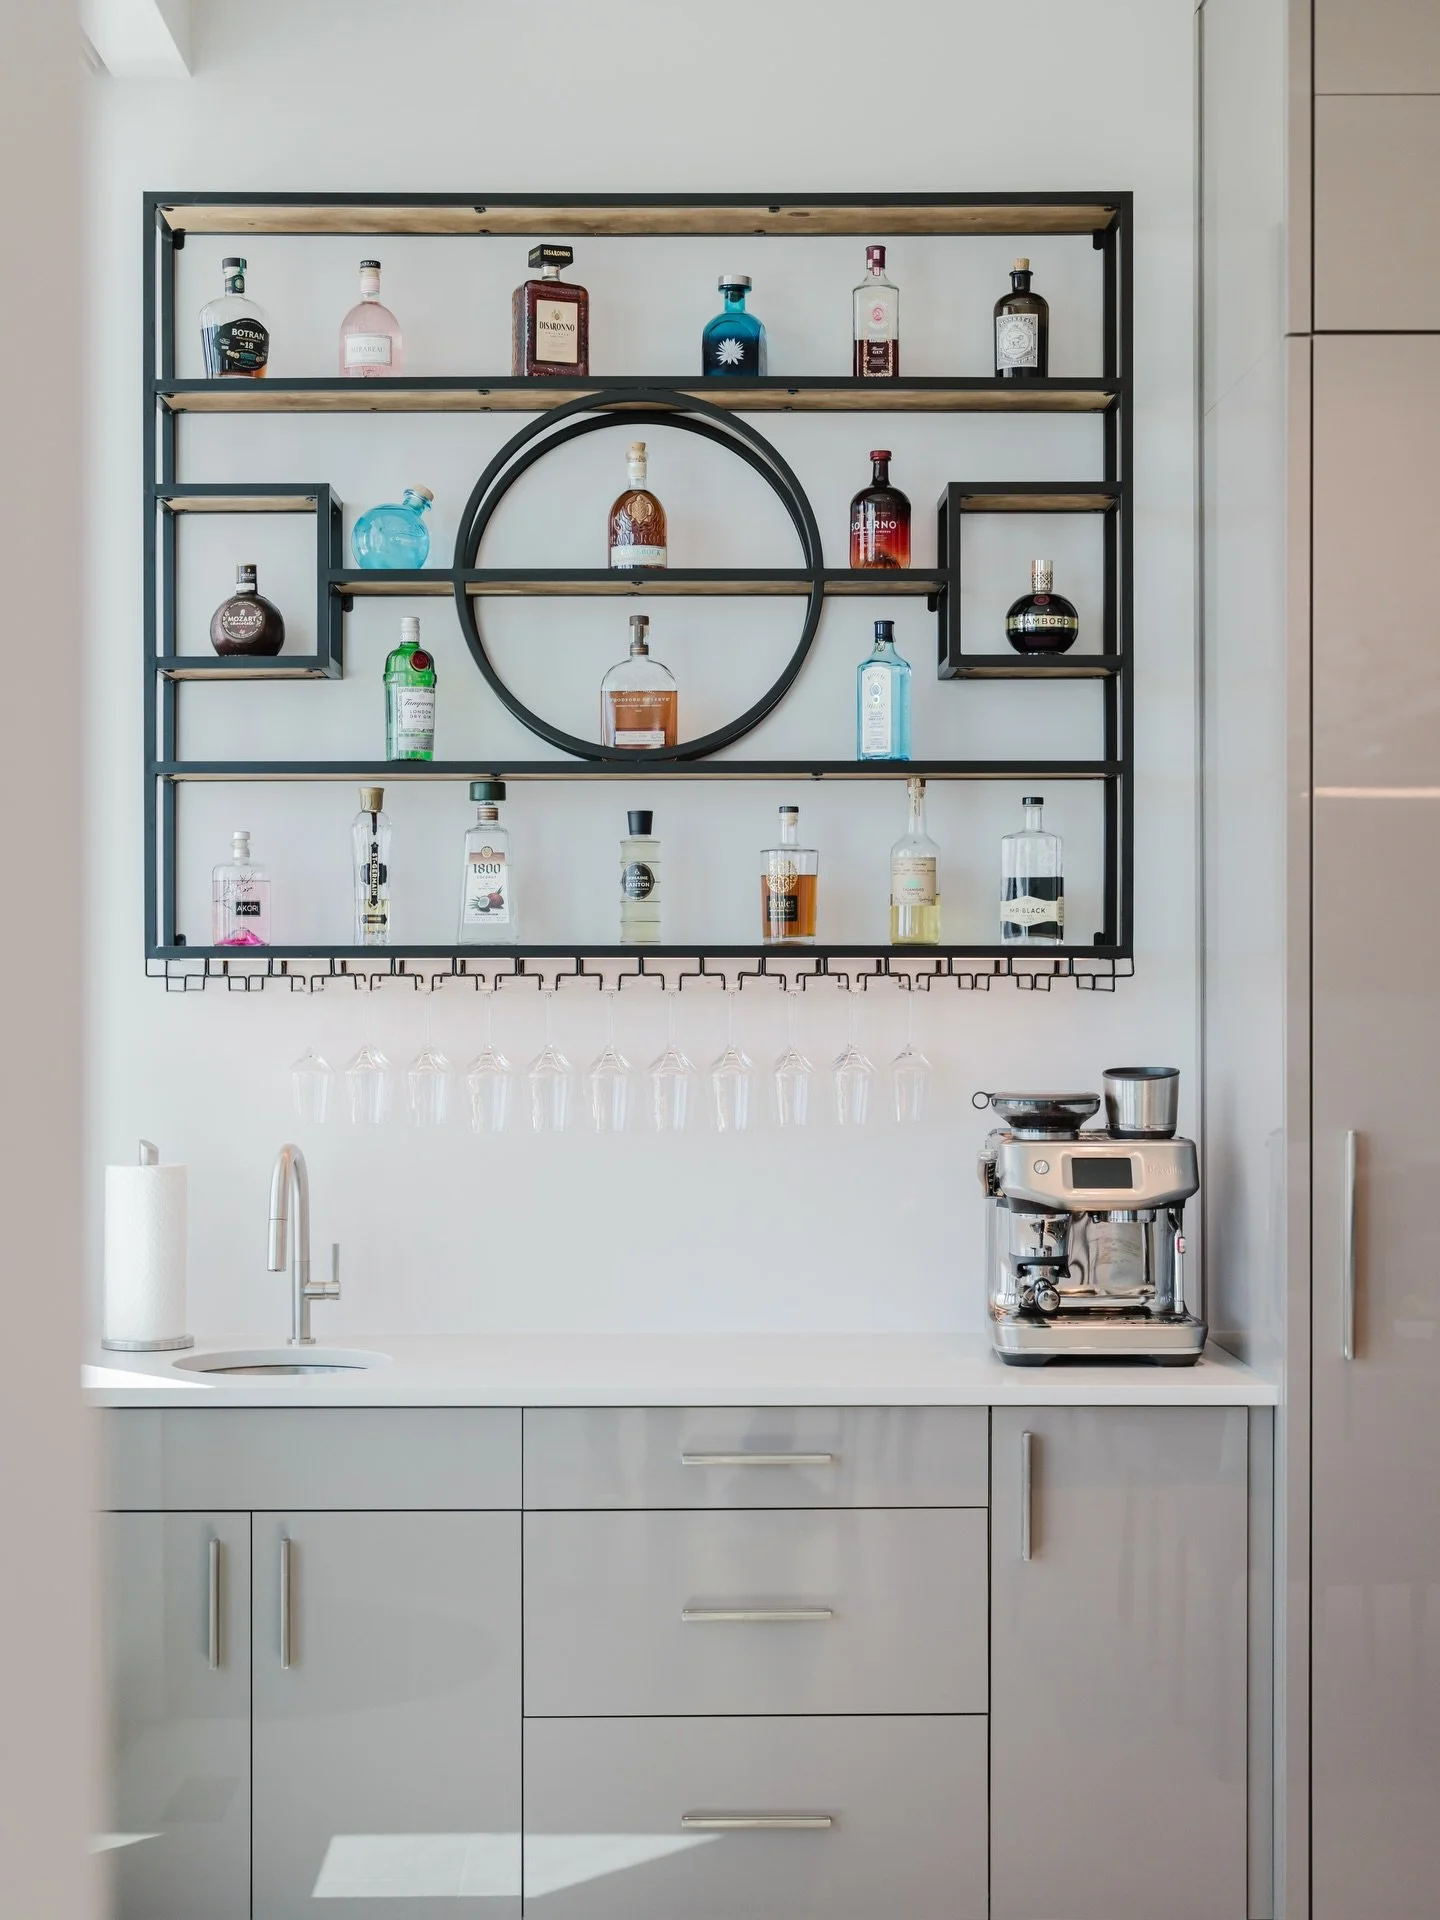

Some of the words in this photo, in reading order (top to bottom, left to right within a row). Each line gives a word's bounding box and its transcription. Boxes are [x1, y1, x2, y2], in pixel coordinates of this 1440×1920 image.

[543, 249, 571, 257] DISARONNO
[539, 321, 575, 332] DISARONNO
[231, 328, 265, 340] BOTRAN
[245, 341, 254, 349] 18
[851, 520, 897, 531] SOLERNO
[1014, 617, 1069, 626] CHAMBORD
[473, 863, 501, 874] 1800
[236, 904, 259, 912] AKORI
